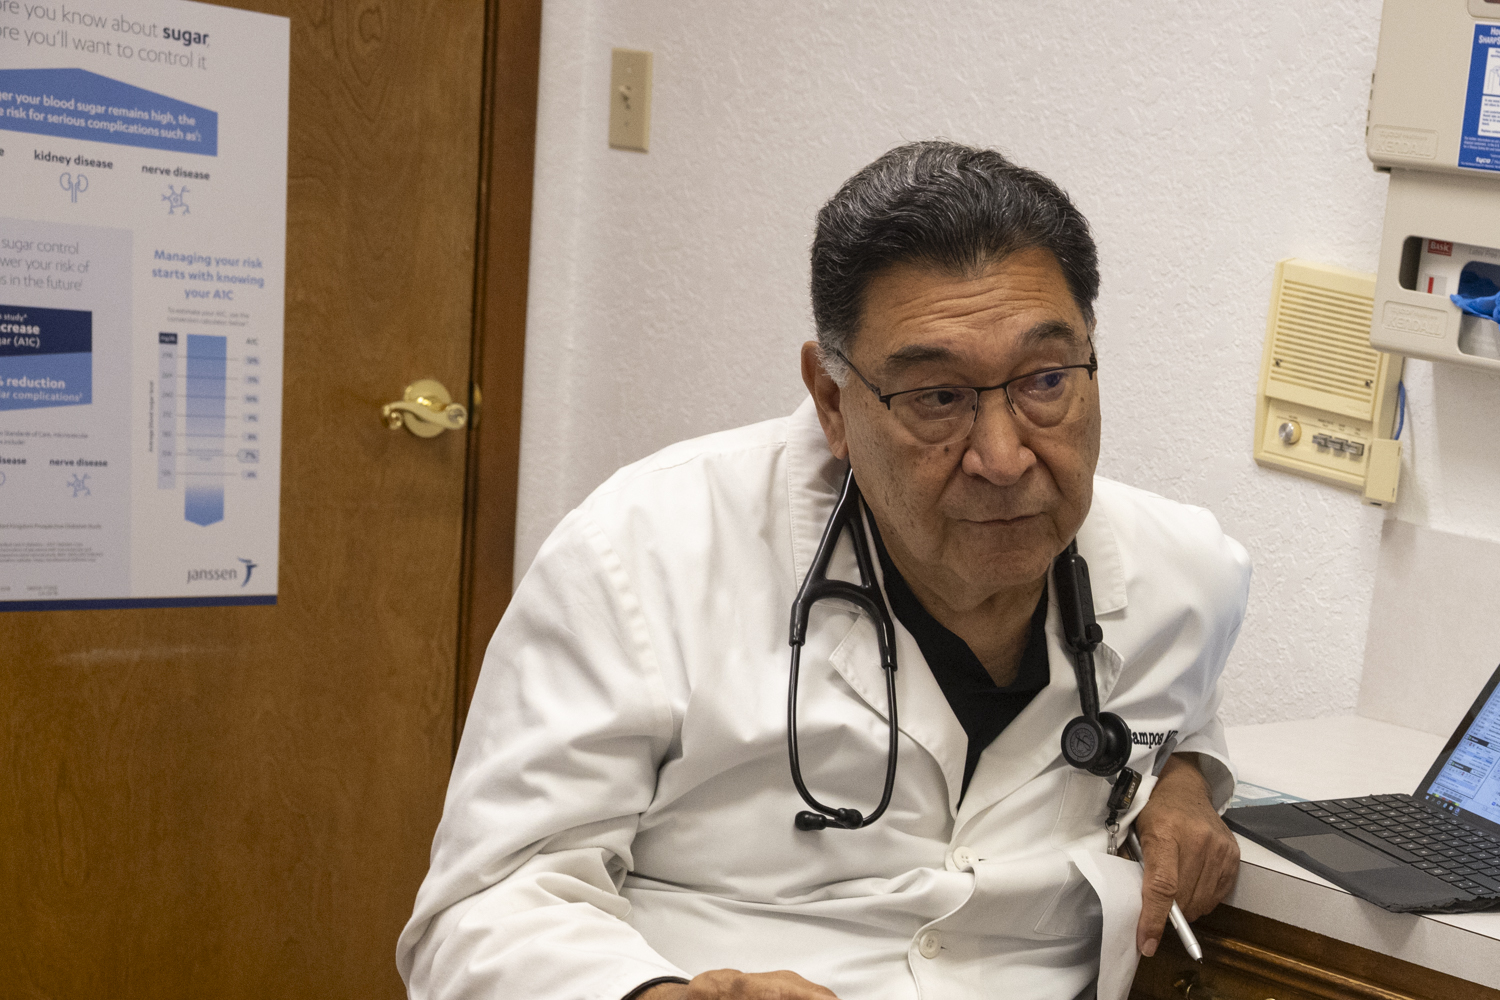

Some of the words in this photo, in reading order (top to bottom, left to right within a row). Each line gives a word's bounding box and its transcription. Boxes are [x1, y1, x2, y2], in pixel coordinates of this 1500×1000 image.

[24, 3, 56, 20] you
[62, 5, 107, 29] know
[112, 14, 158, 38] about
[163, 26, 210, 48] sugar,
[72, 37, 111, 56] want
[117, 42, 133, 58] to
[138, 48, 193, 68] control
[198, 55, 207, 70] it
[16, 93, 40, 105] your
[43, 95, 75, 110] blood
[77, 101, 106, 115] sugar
[108, 105, 149, 120] remains
[151, 111, 176, 125] high,
[178, 114, 196, 126] the
[6, 107, 26, 119] risk
[28, 108, 46, 122] for
[47, 112, 86, 127] serious
[88, 117, 159, 137] complications
[160, 128, 184, 140] such
[34, 149, 71, 166] kidney
[74, 155, 113, 170] disease
[142, 165, 171, 176] nerve
[173, 166, 210, 180] disease
[1, 239, 33, 253] sugar
[37, 242, 79, 255] control
[25, 259, 51, 271] your
[56, 259, 75, 272] risk
[78, 260, 90, 274] of
[154, 249, 211, 267] Managing
[214, 257, 240, 267] your
[242, 257, 262, 269] risk
[10, 274, 20, 286] in
[24, 274, 44, 288] the
[152, 268, 185, 280] starts
[188, 269, 214, 281] with
[216, 271, 264, 288] knowing
[184, 289, 210, 299] your
[6, 375, 66, 389] reduction
[49, 458, 74, 466] nerve
[76, 458, 108, 467] disease
